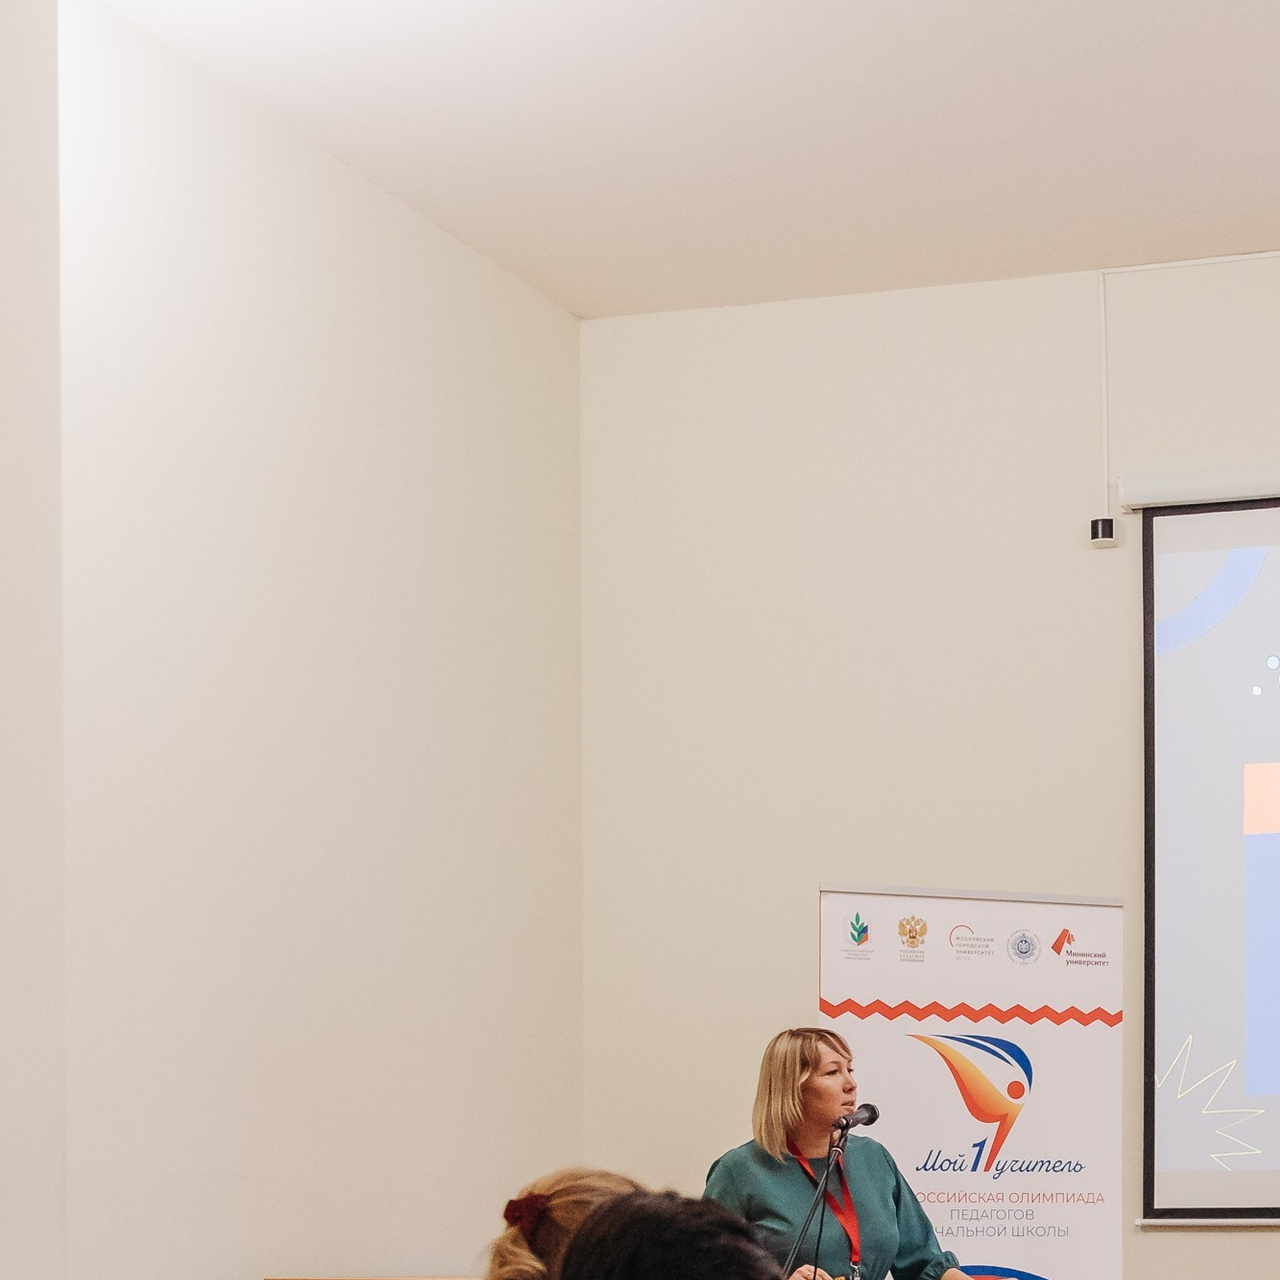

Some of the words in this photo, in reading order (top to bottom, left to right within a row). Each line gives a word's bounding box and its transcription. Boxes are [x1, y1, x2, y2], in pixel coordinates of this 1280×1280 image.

[1065, 949, 1107, 958] Мининский
[1065, 959, 1110, 967] университет
[915, 1149, 968, 1173] Мой
[992, 1159, 1087, 1180] учитель
[915, 1189, 1005, 1205] ОССИЙСКАЯ
[1008, 1191, 1106, 1206] ОЛИМПИАДА
[949, 1208, 1035, 1223] ПЕДАГОГОВ
[934, 1224, 1007, 1238] ЧАЛЬНОЙ
[1011, 1225, 1070, 1238] ШКОЛЫ
